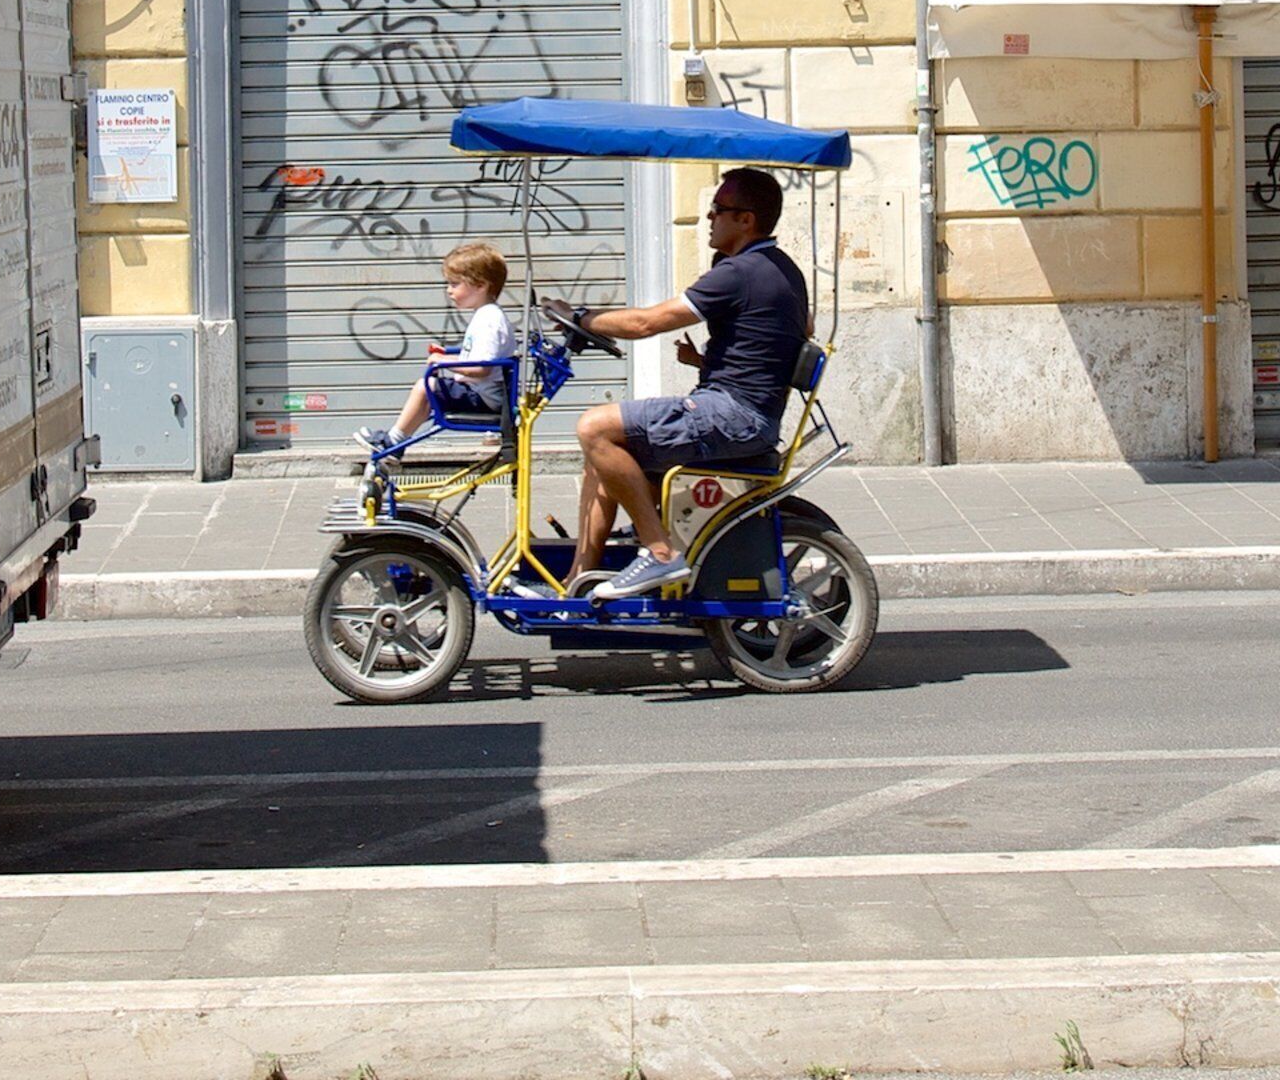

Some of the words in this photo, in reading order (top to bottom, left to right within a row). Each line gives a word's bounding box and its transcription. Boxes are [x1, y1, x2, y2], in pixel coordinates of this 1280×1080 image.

[95, 94, 134, 104] FLAMINIO
[136, 93, 169, 103] CENTRO
[119, 106, 145, 116] COPIE
[115, 116, 159, 126] trasferito
[161, 115, 171, 125] in
[696, 484, 720, 503] 17
